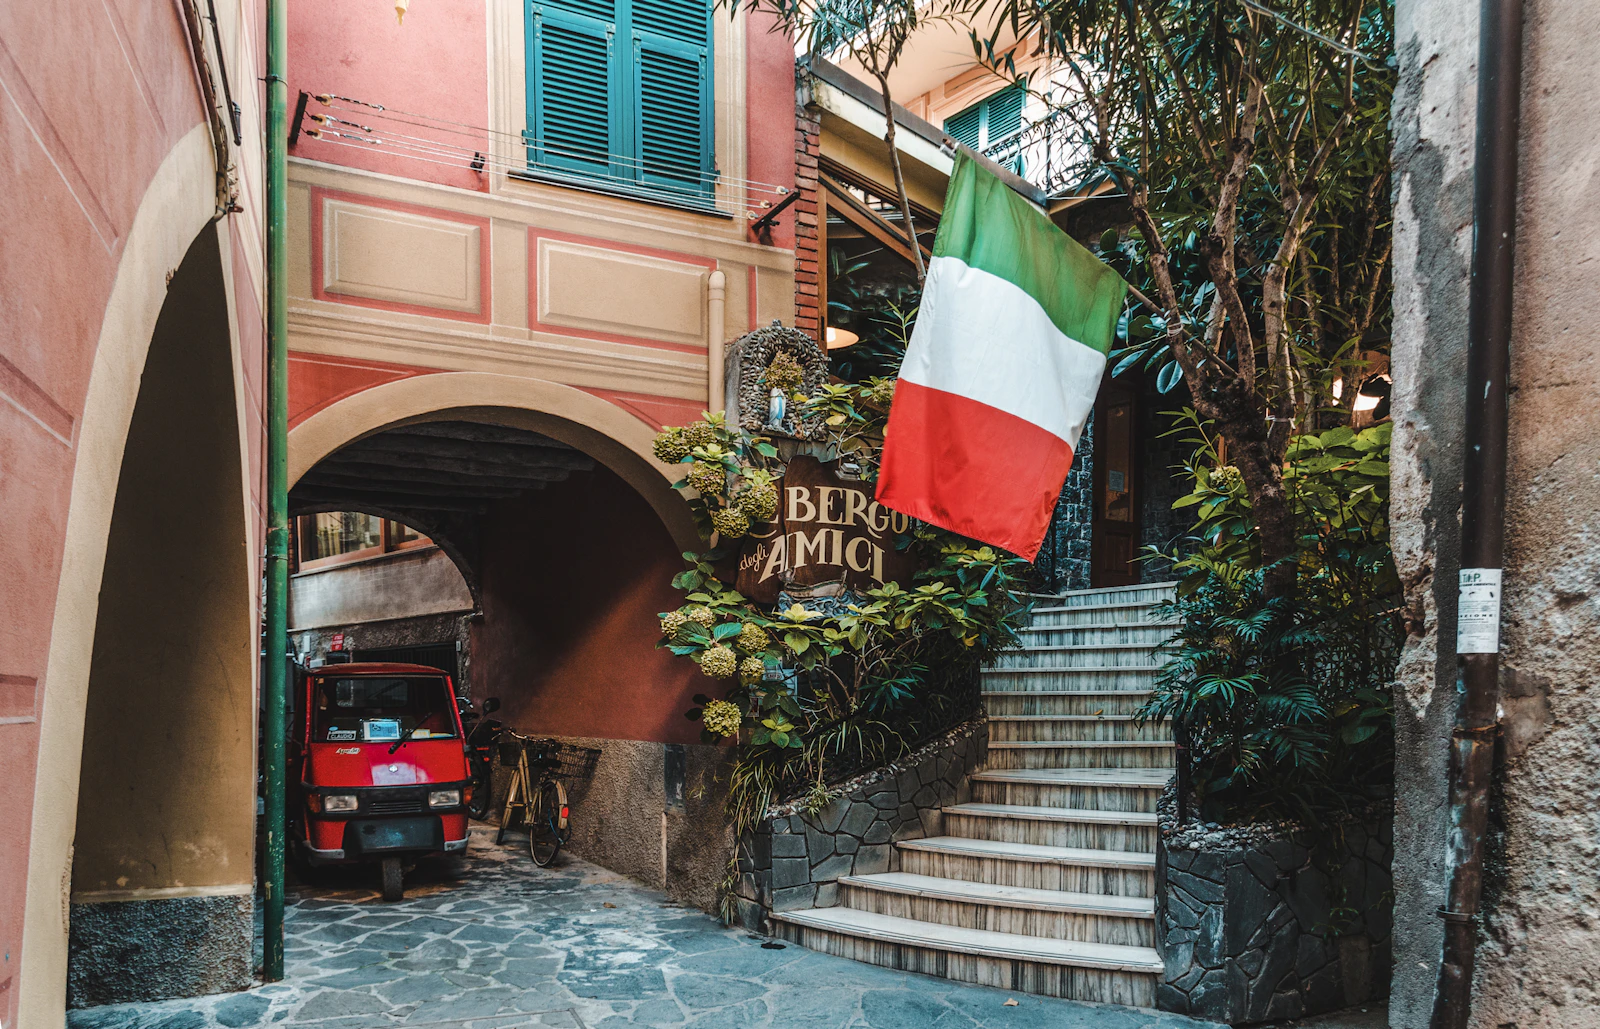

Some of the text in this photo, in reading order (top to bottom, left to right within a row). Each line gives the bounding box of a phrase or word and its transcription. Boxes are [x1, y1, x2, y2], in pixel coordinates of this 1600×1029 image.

[767, 486, 909, 539] BERGO
[739, 527, 886, 585] degli AMICI
